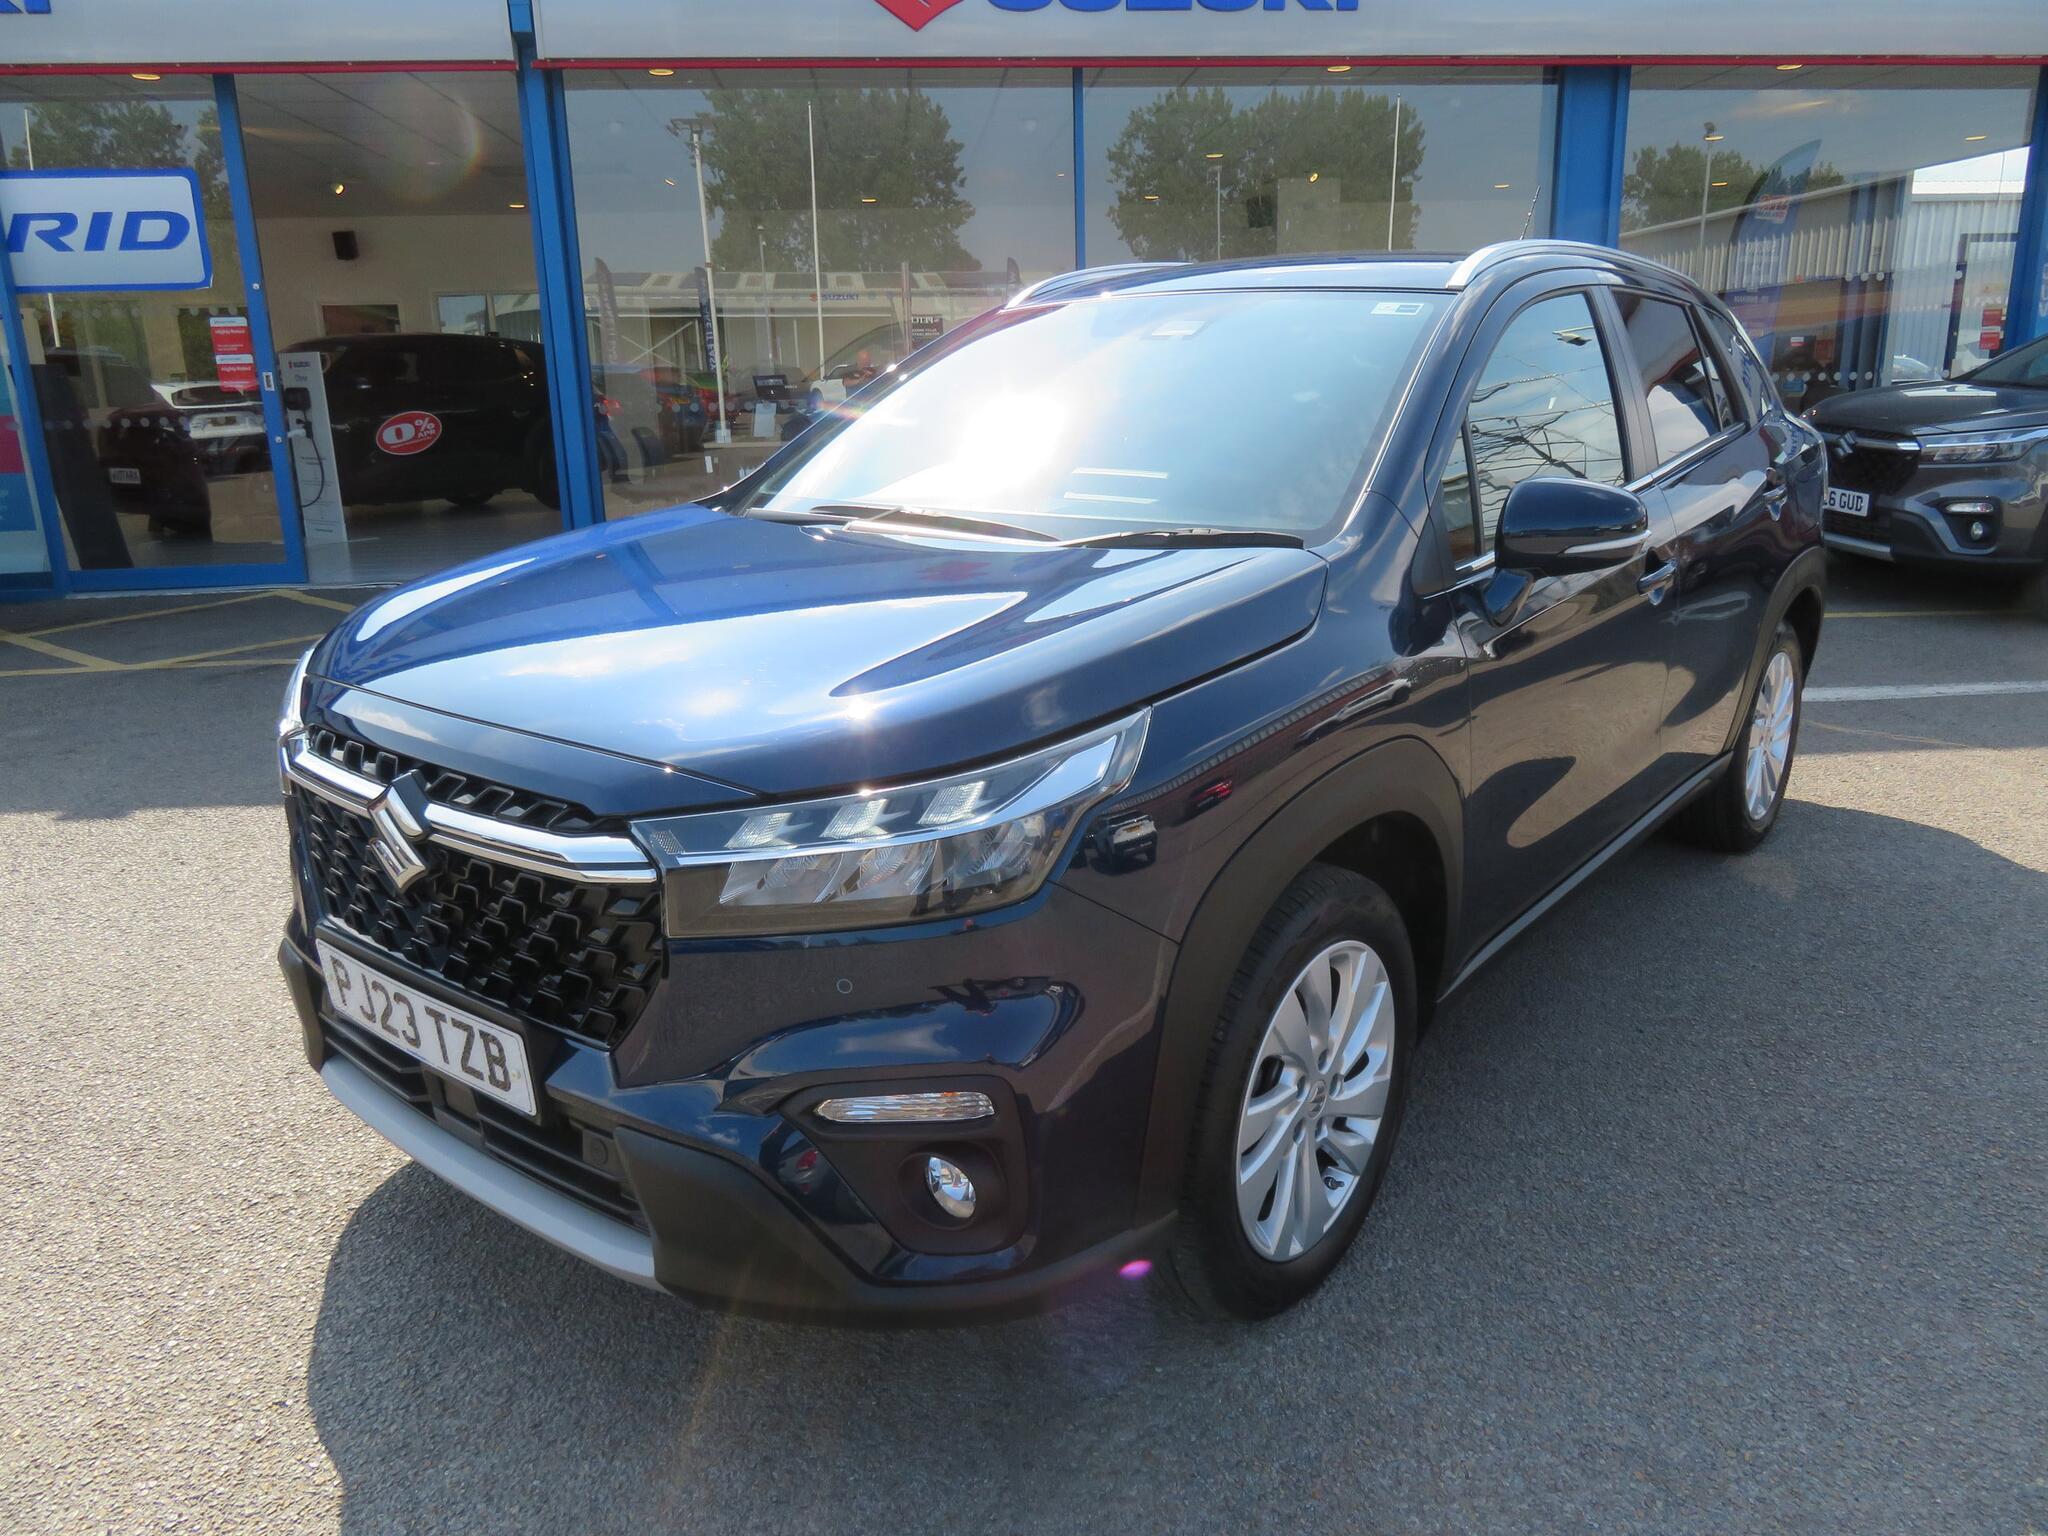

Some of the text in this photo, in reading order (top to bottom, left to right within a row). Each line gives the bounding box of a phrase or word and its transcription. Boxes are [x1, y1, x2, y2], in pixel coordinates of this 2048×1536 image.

[1839, 493, 1864, 512] GUD
[330, 955, 512, 1092] PJ23 TZB
